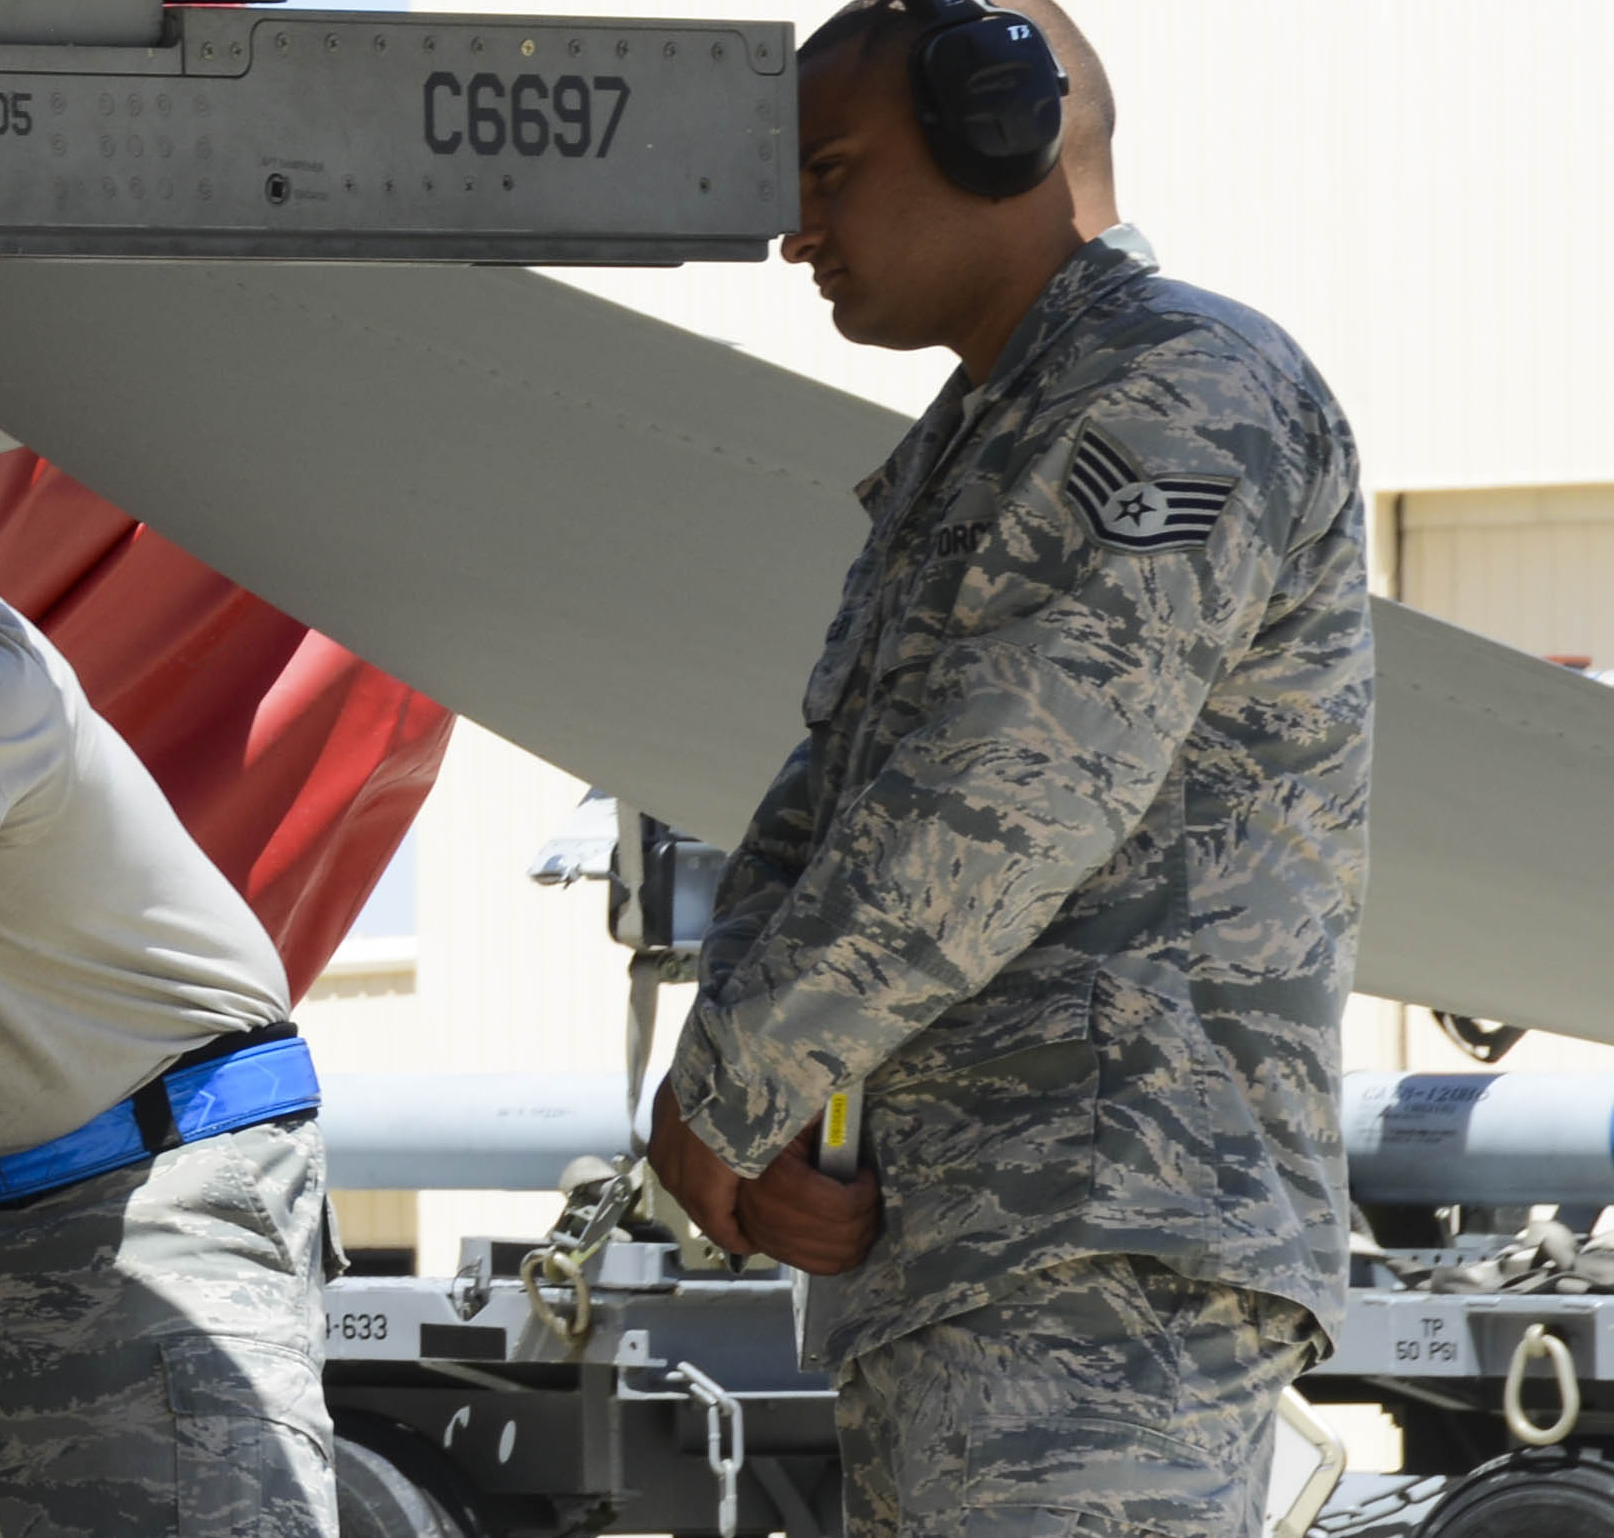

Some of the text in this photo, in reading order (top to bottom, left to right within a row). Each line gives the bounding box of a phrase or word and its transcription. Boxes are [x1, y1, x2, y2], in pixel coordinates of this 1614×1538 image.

[424, 71, 631, 158] C6697
[1420, 1318, 1445, 1338] TP
[1428, 1341, 1457, 1360] PSI
